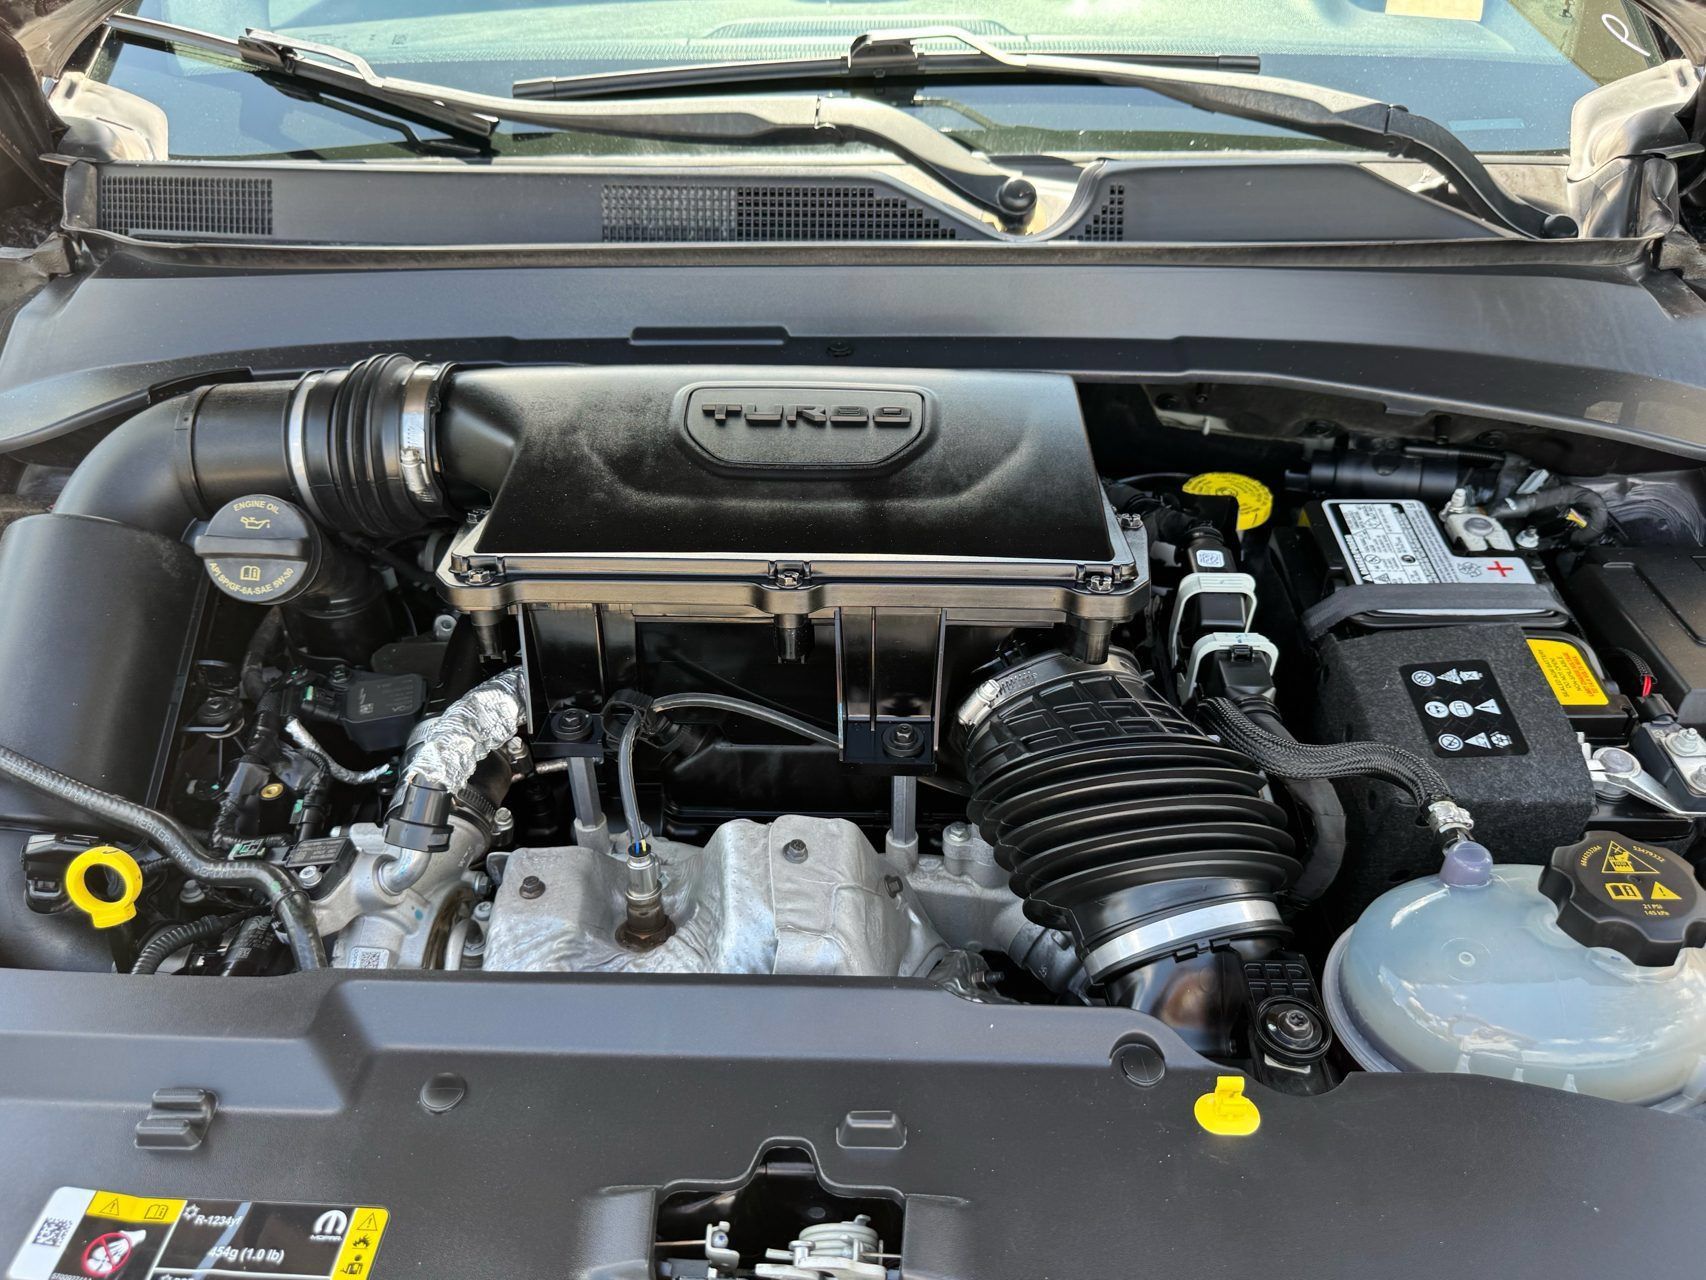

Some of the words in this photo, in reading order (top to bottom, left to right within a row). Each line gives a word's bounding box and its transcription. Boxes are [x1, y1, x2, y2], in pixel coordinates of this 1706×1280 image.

[701, 403, 912, 423] TURBO
[233, 500, 266, 512] ENGINE
[266, 503, 280, 514] OIL
[208, 562, 220, 578] API
[273, 567, 294, 589] 5W-30
[135, 815, 170, 847] HEATER
[194, 1214, 243, 1228] R-1234yf
[208, 1246, 237, 1262] 454g
[240, 1248, 264, 1262] (1.0
[265, 1250, 285, 1265] lb)
